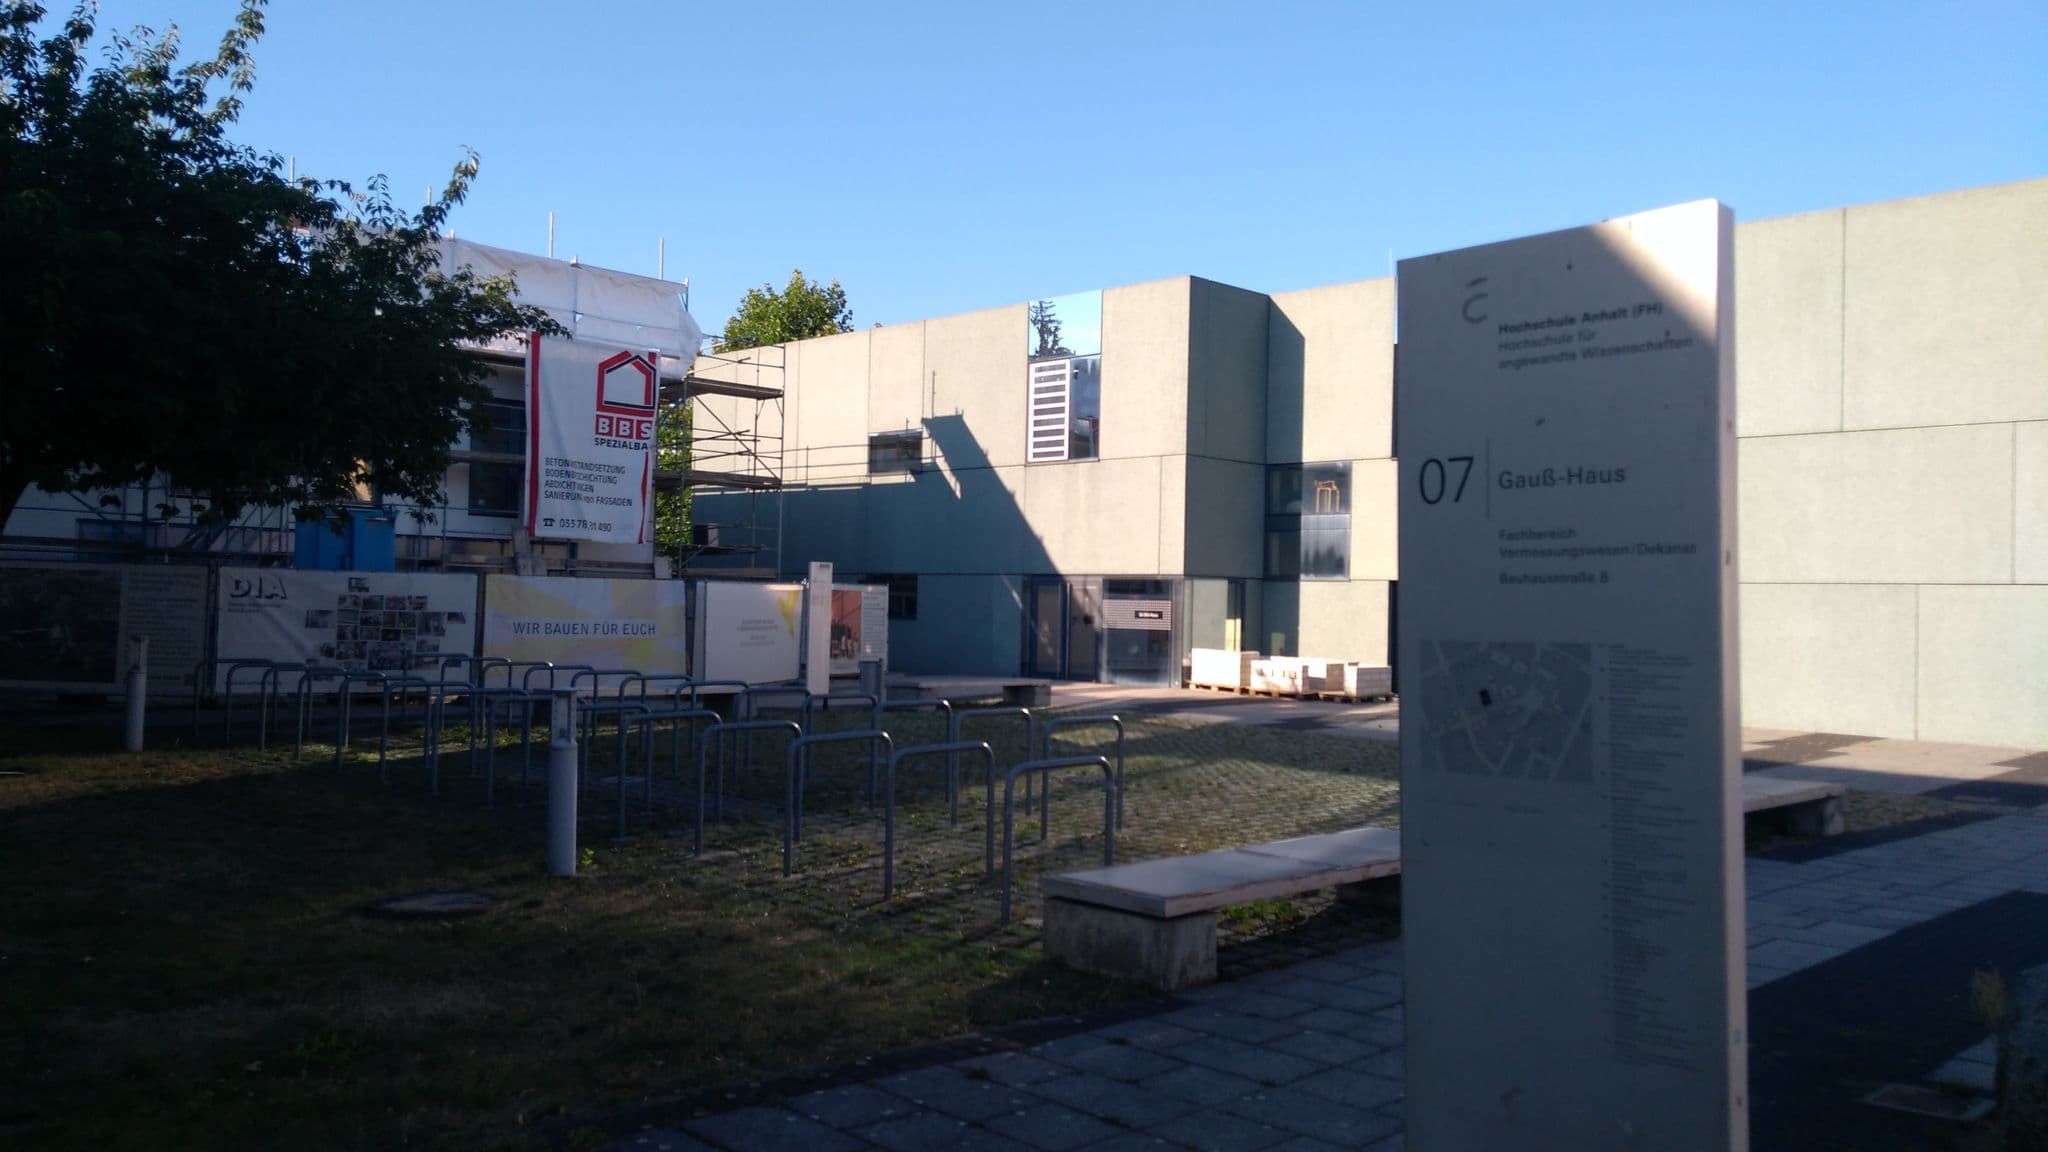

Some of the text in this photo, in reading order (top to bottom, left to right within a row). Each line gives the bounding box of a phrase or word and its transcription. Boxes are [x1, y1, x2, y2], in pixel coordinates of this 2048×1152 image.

[1498, 302, 1662, 335] Hochschule Anhalt (FH)
[1498, 328, 1597, 352] Hochschule für
[1498, 337, 1692, 370] angewandte Wissenschaften
[598, 417, 651, 438] BBS
[1419, 456, 1474, 505] 07
[1499, 466, 1626, 490] Gauß-Haus
[544, 490, 583, 502] SANIERUN
[596, 496, 633, 507] FASSADEN
[1499, 528, 1576, 541] Fachbereich
[229, 577, 287, 599] DIA
[1499, 571, 1595, 585] Bauhausstraße
[513, 620, 656, 635] WIR BAUEN FÜR EUCH
